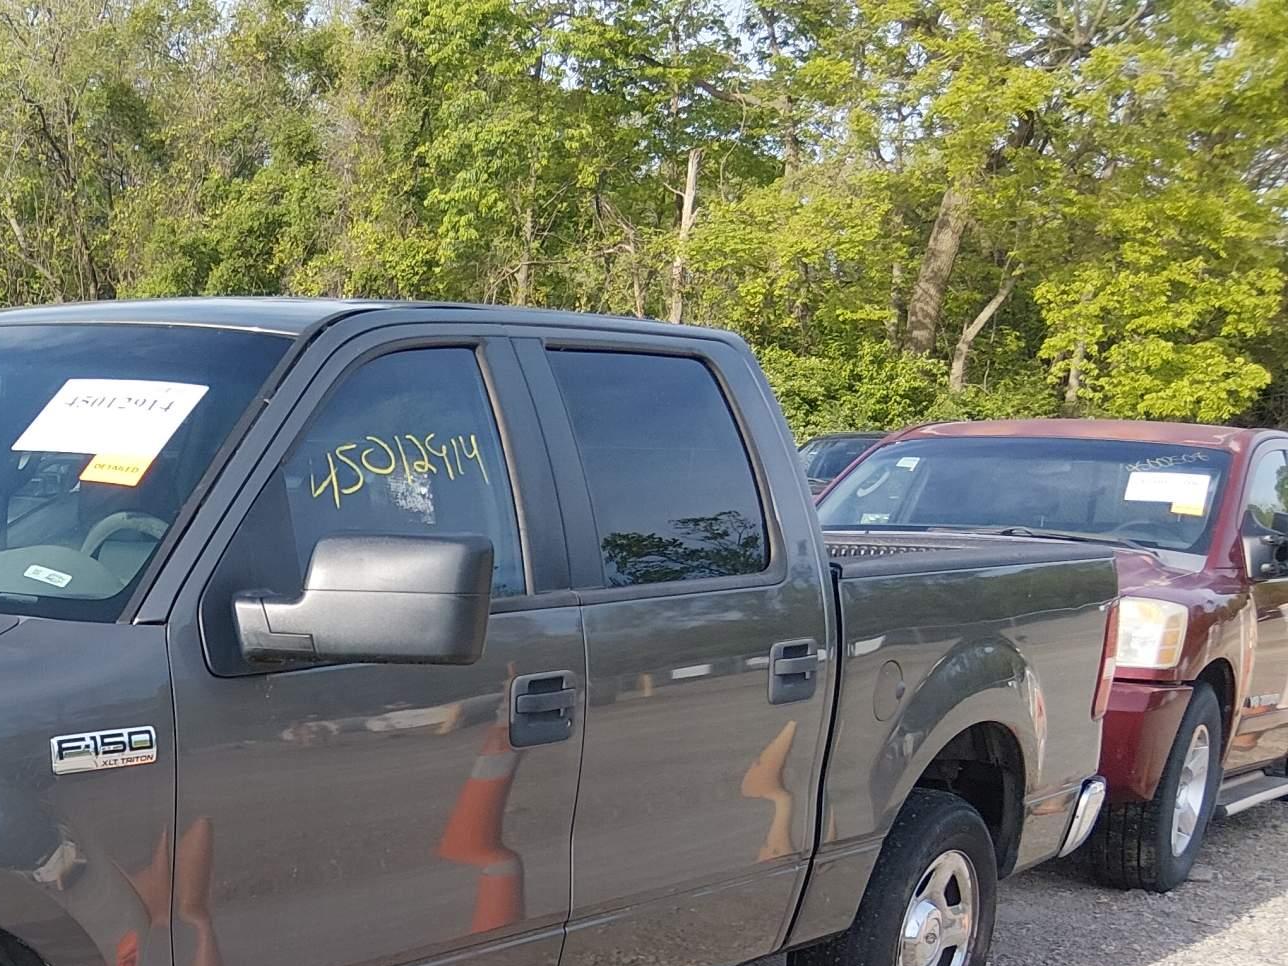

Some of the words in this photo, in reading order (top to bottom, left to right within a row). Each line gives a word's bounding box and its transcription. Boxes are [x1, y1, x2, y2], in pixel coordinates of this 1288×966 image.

[309, 432, 490, 510] 45012914
[102, 758, 119, 767] XLT
[120, 754, 155, 766] TRITON
